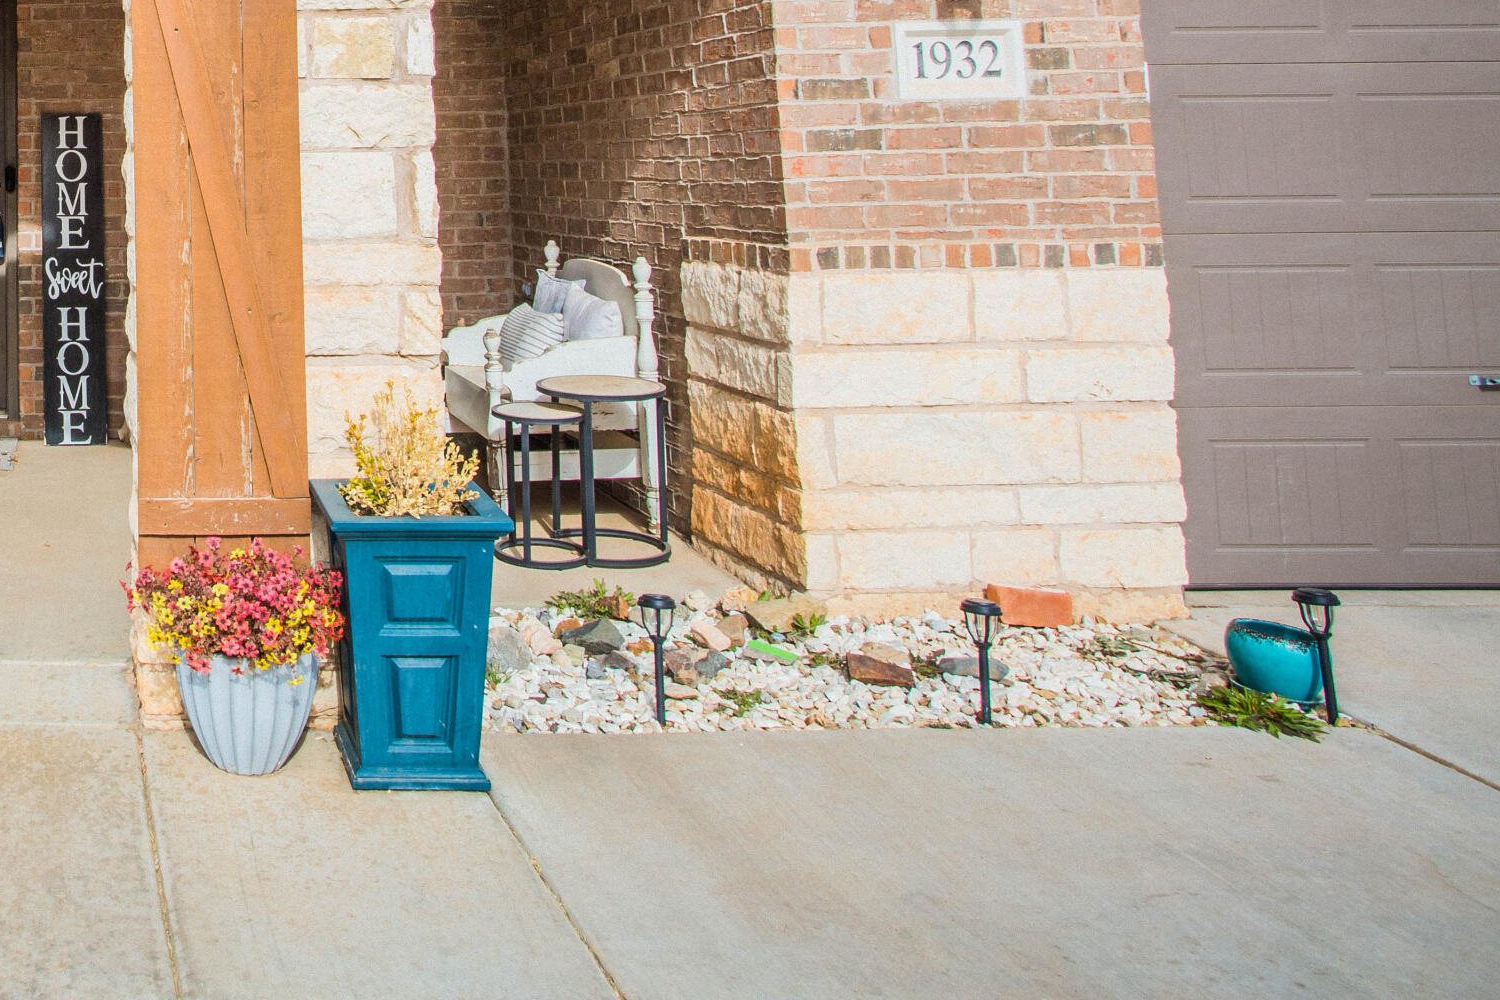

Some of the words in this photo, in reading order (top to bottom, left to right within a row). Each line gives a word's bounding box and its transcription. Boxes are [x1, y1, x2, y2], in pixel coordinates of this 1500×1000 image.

[912, 40, 1002, 80] 1932
[55, 115, 90, 249] HOME
[45, 257, 104, 299] Sweet
[56, 307, 92, 445] HOME
